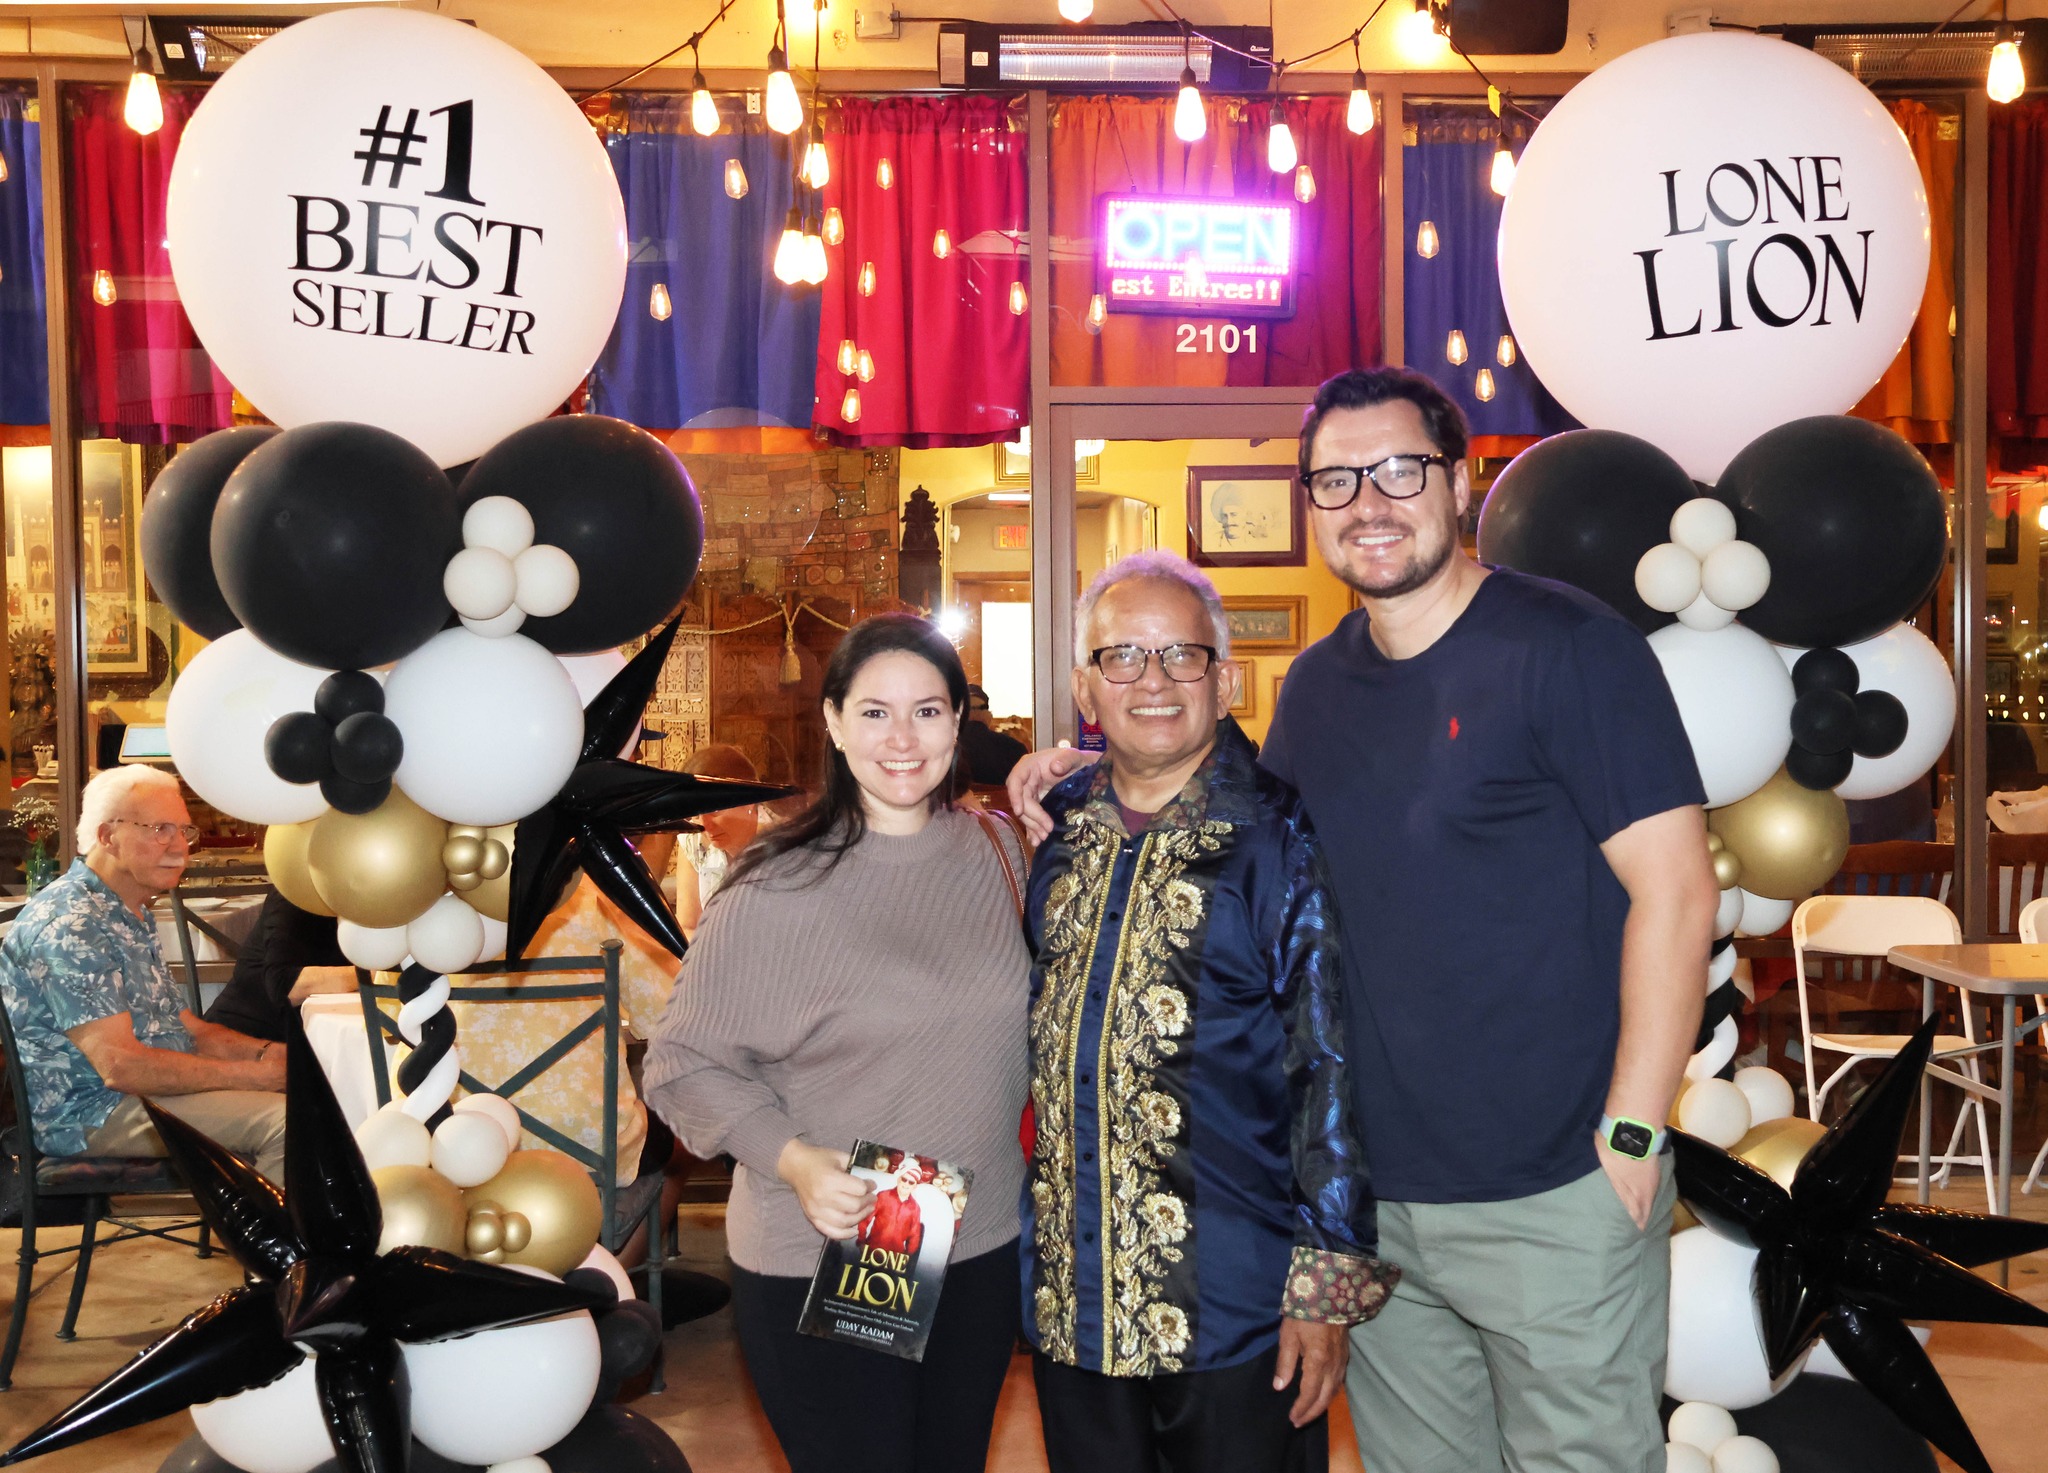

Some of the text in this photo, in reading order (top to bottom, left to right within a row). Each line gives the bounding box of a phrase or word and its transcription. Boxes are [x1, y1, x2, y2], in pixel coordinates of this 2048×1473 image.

[354, 99, 486, 207] #1
[1659, 156, 1850, 237] LONE
[287, 194, 544, 298] BEST
[1114, 210, 1283, 263] OPEN
[1633, 230, 1874, 341] LION
[291, 277, 536, 355] SELLER
[1176, 323, 1257, 354] 2101
[999, 525, 1027, 548] EXIT
[860, 1244, 910, 1273] LONE
[836, 1263, 919, 1313] LION
[836, 1319, 860, 1332] UDAY
[860, 1324, 895, 1341] KADAM
